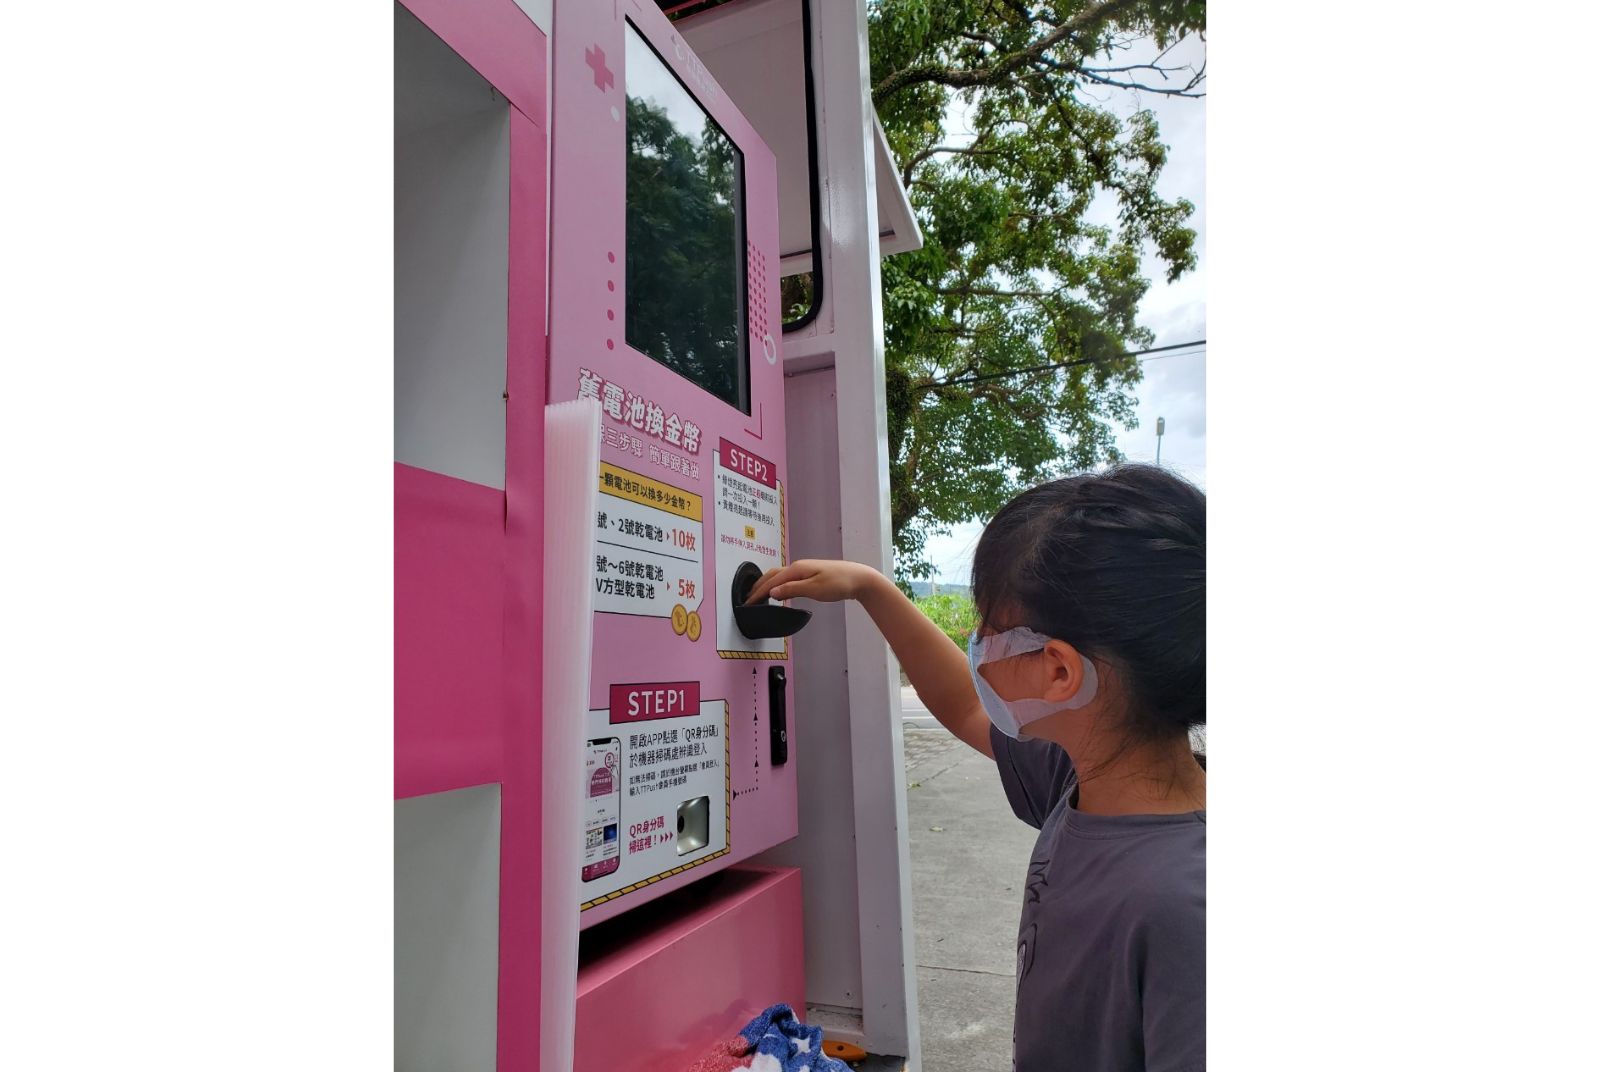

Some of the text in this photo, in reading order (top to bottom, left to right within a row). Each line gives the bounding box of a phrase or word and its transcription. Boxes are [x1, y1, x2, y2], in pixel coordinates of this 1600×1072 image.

[577, 367, 701, 453] 舊電池換金幣
[730, 448, 768, 482] STEP2
[672, 528, 696, 552] 10枚
[678, 579, 696, 599] 5枚
[627, 689, 685, 716] STEP1
[629, 815, 665, 838] QR身分碼
